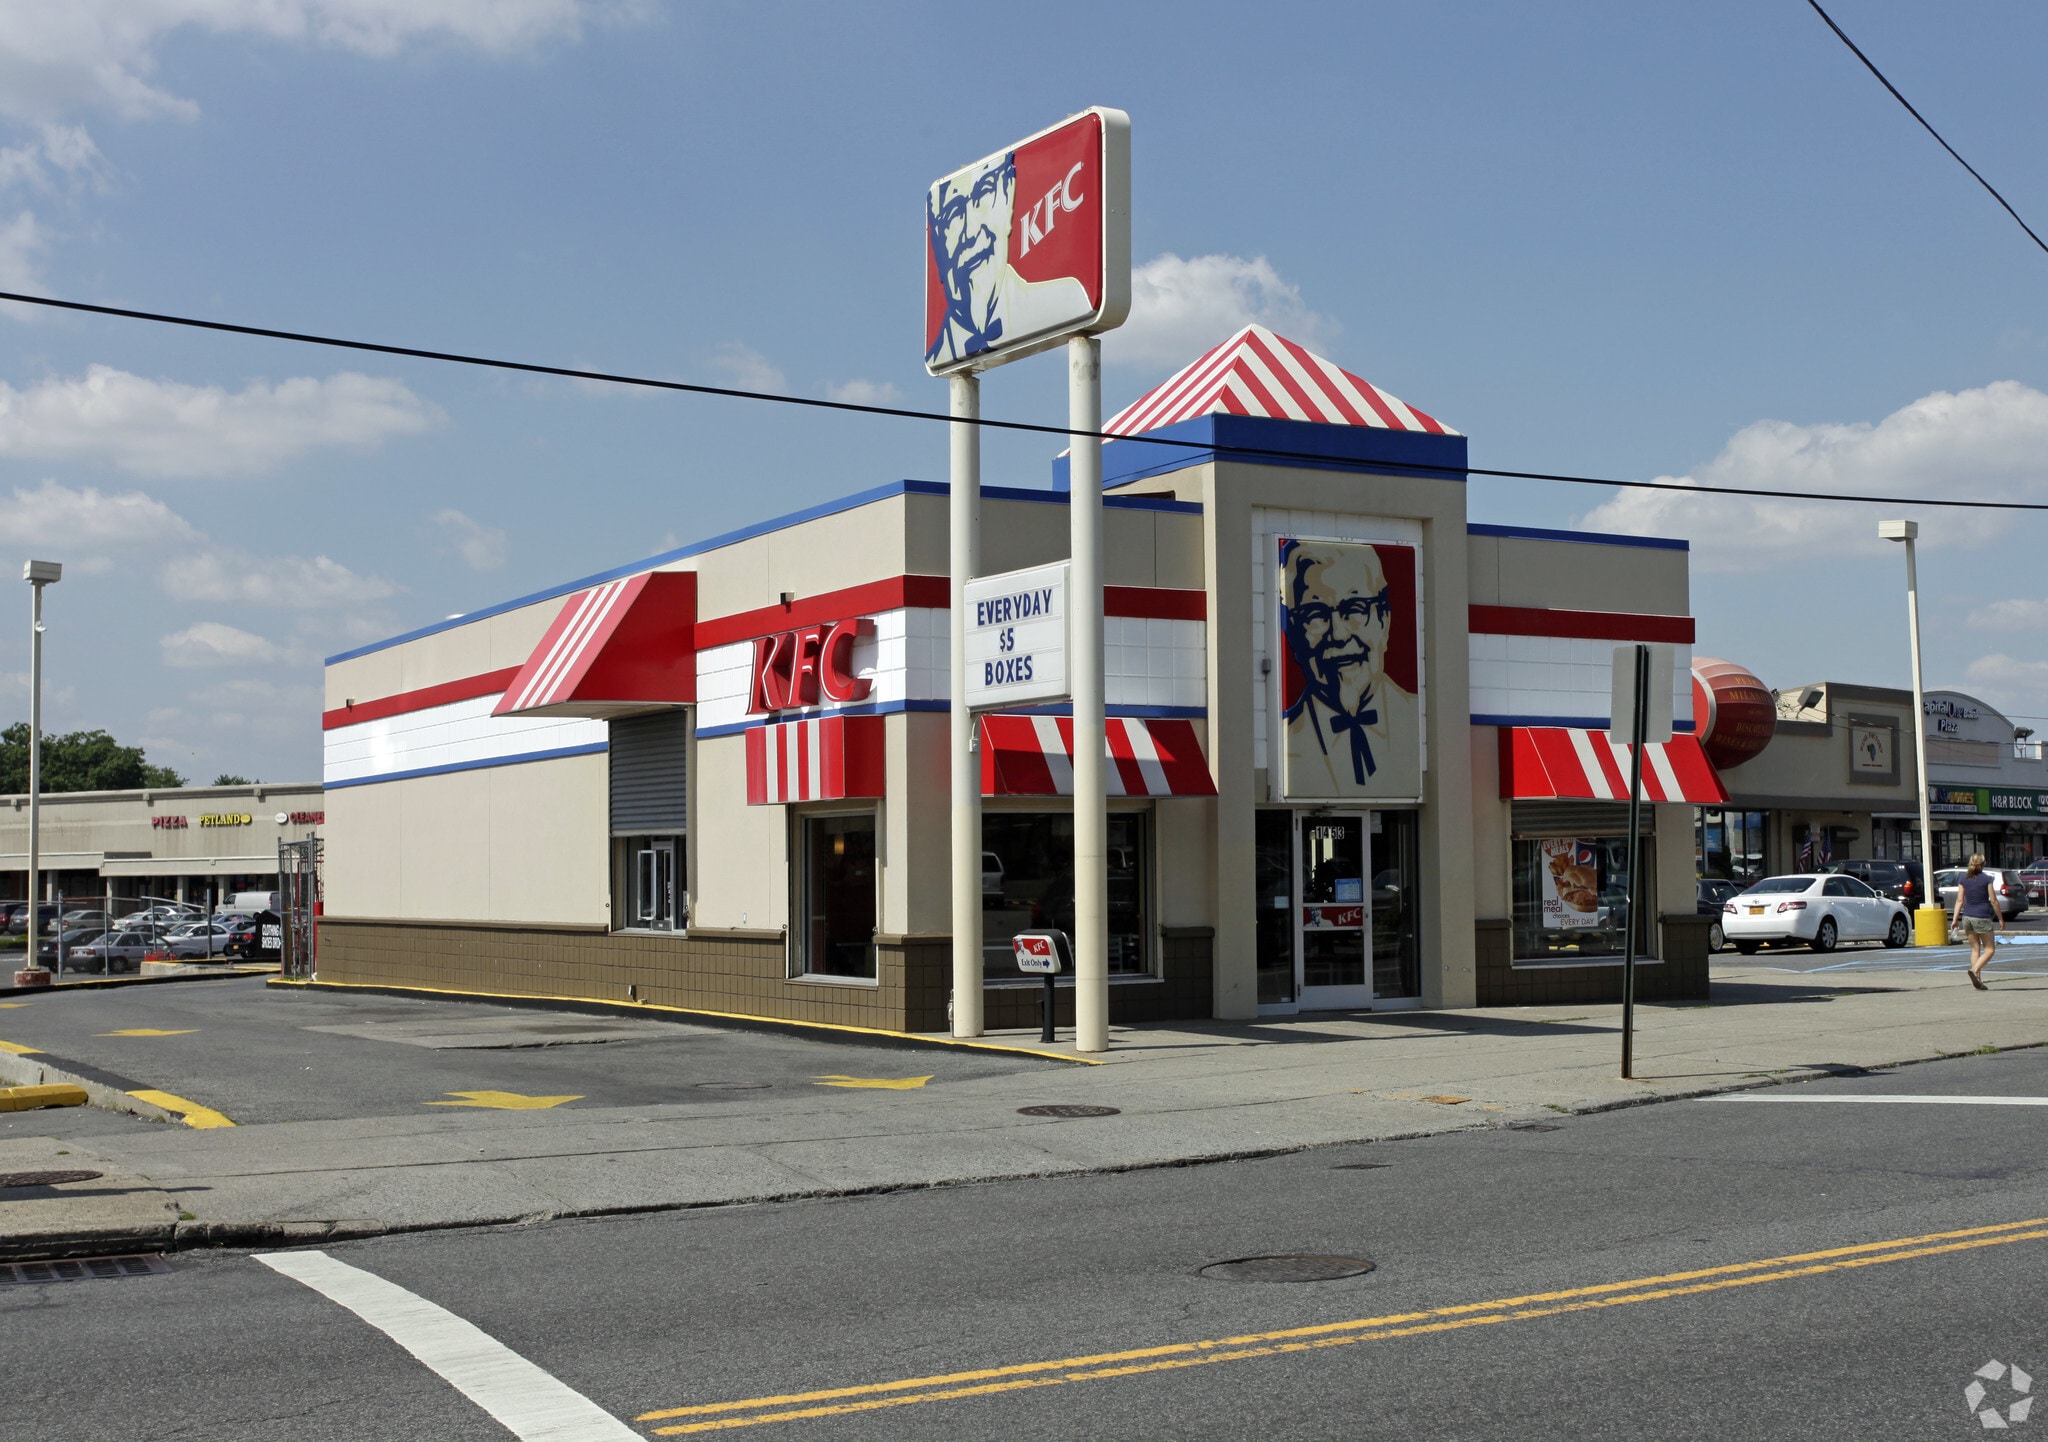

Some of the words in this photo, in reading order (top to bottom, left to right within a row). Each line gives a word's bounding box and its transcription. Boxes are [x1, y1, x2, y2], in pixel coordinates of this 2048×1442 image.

[1019, 161, 1083, 258] KFC
[977, 589, 1052, 626] EVERYDAY
[1000, 627, 1014, 652] $5
[745, 618, 874, 715] KFC
[985, 655, 1032, 686] BOXES
[1963, 707, 1978, 719] Bank
[1939, 718, 1959, 732] Plaza
[1992, 795, 2008, 809] H&R
[2009, 796, 2032, 810] BLOCK
[152, 816, 187, 828] PIZZA
[200, 814, 240, 825] PETLAND
[1316, 826, 1344, 839] 1453
[1544, 896, 1558, 906] real
[1543, 903, 1562, 913] meal
[1338, 907, 1361, 925] KFC
[1033, 940, 1046, 953] KFC
[1031, 959, 1042, 968] Only
